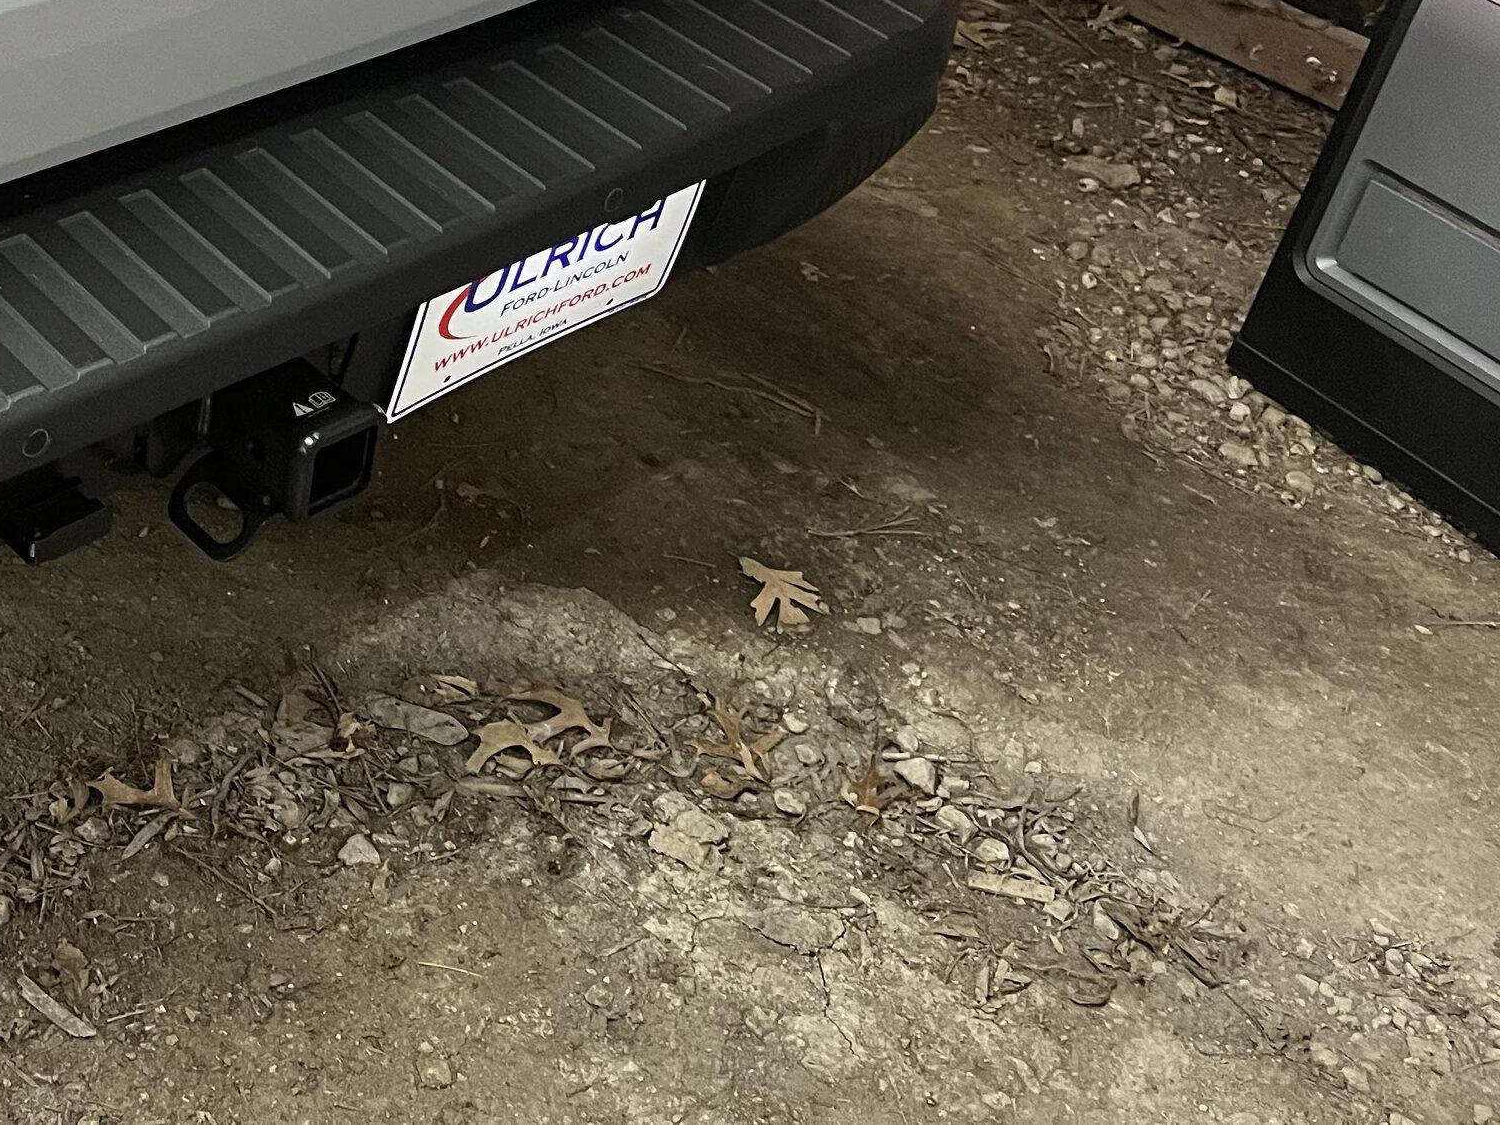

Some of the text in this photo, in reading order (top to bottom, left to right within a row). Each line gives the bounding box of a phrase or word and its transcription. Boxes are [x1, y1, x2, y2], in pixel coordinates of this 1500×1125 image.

[464, 196, 667, 314] ULRICH
[500, 250, 629, 317] FORD-LINCOLN
[434, 263, 652, 372] WWW.ULRICHFORD.COM
[540, 319, 568, 336] IOWA
